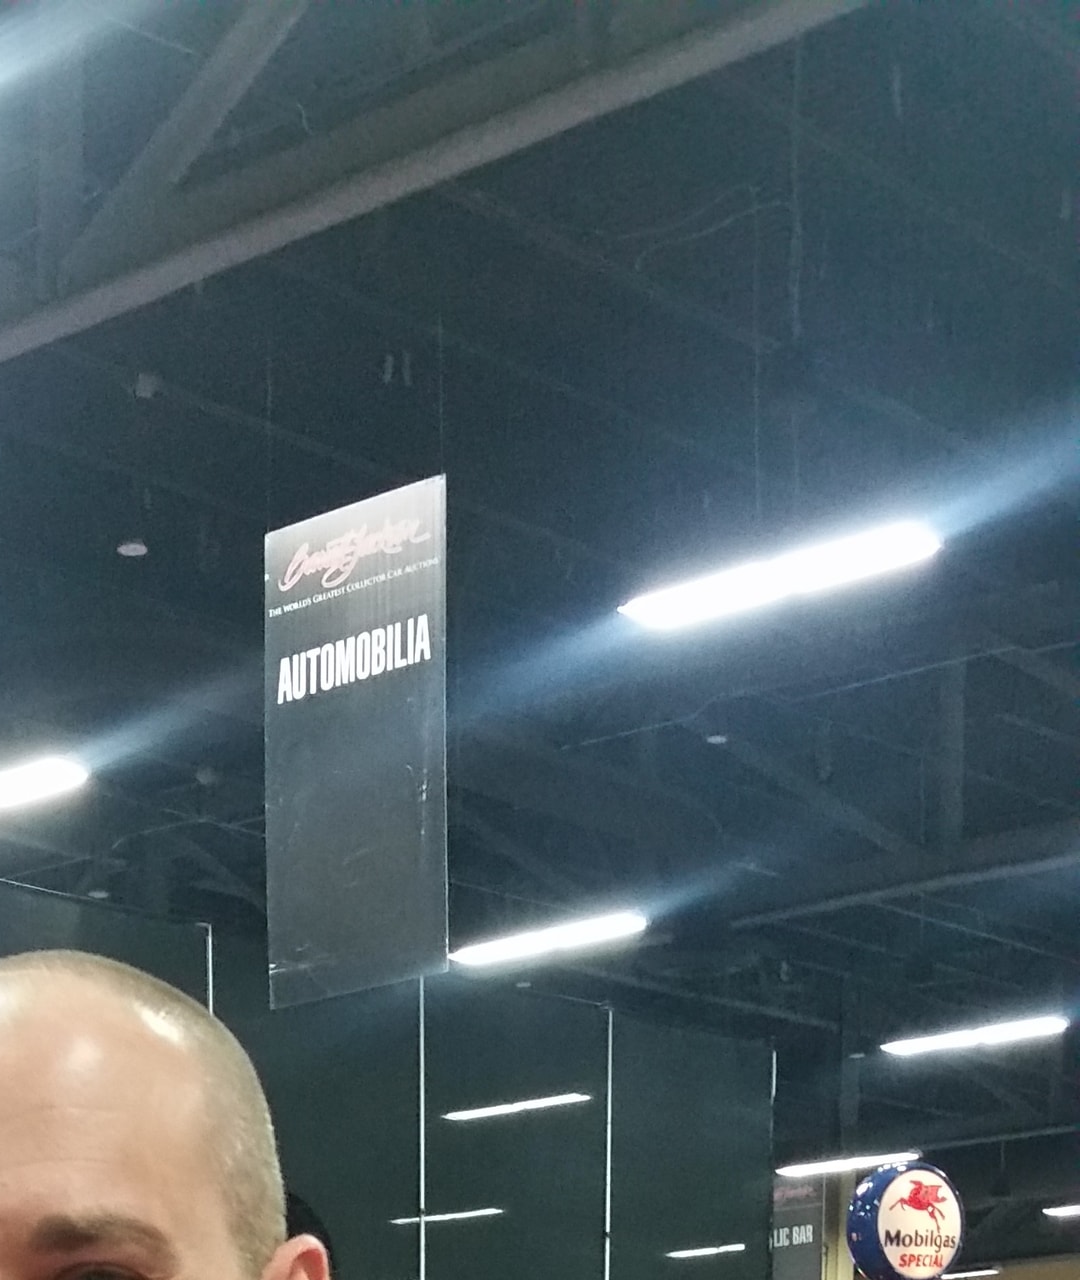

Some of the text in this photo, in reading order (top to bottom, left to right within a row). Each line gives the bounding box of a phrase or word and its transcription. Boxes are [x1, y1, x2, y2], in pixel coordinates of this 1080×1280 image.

[268, 606, 282, 617] THE
[312, 586, 345, 603] GREATEST
[346, 573, 386, 592] COLLECTOR
[387, 568, 402, 579] CAR
[404, 556, 439, 573] AUCTIONS
[277, 614, 431, 704] AUTOMOBILIA
[770, 1224, 813, 1248] LIC BAR
[884, 1229, 956, 1253] Mobilgas
[898, 1253, 943, 1268] SPECIAL
